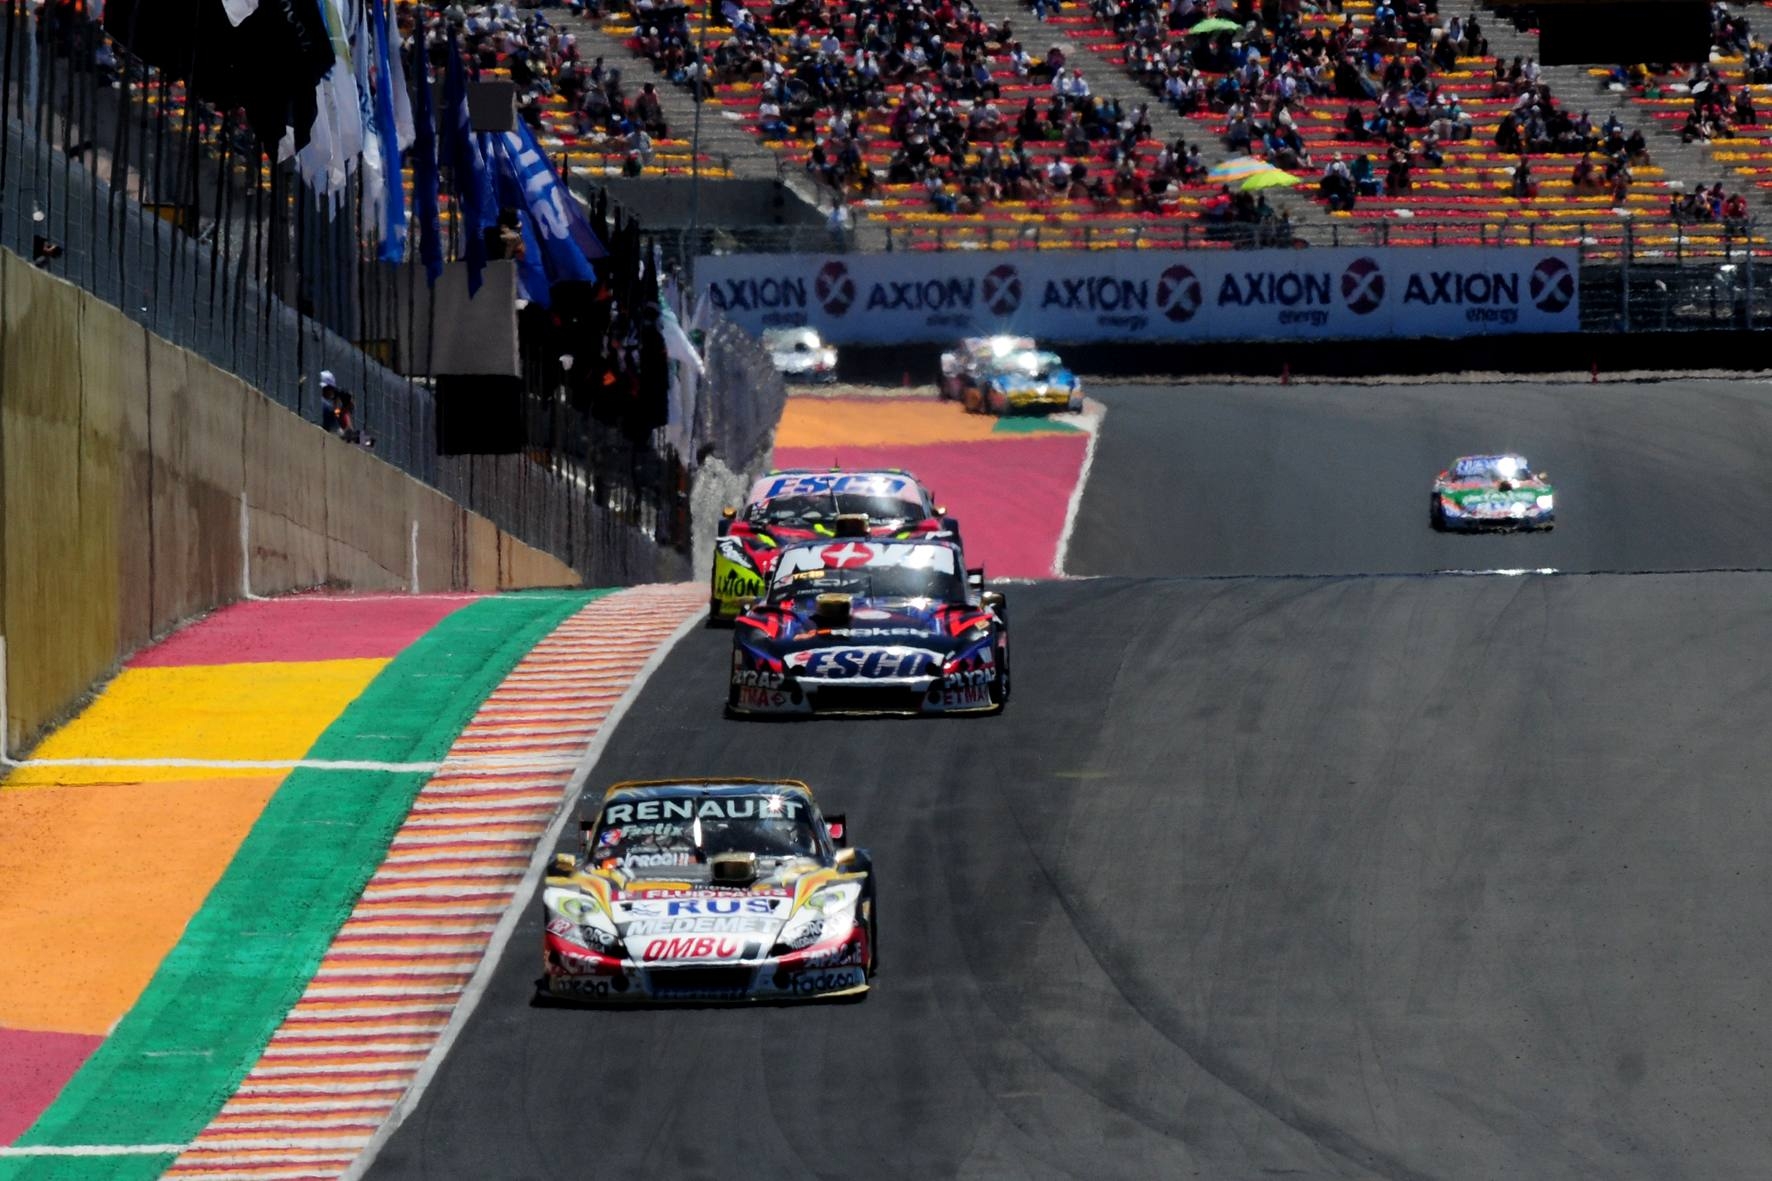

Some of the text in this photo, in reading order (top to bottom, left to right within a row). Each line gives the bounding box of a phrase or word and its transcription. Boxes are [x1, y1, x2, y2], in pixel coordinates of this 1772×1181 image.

[709, 276, 807, 311] AXION
[866, 276, 976, 311] AXION
[1040, 275, 1149, 310] AXION
[1218, 272, 1331, 305] AXION
[1403, 271, 1519, 304] AXION
[1279, 309, 1329, 326] energy
[1465, 306, 1519, 323] energy
[606, 799, 804, 825] RENAULT
[668, 897, 773, 916] RUS
